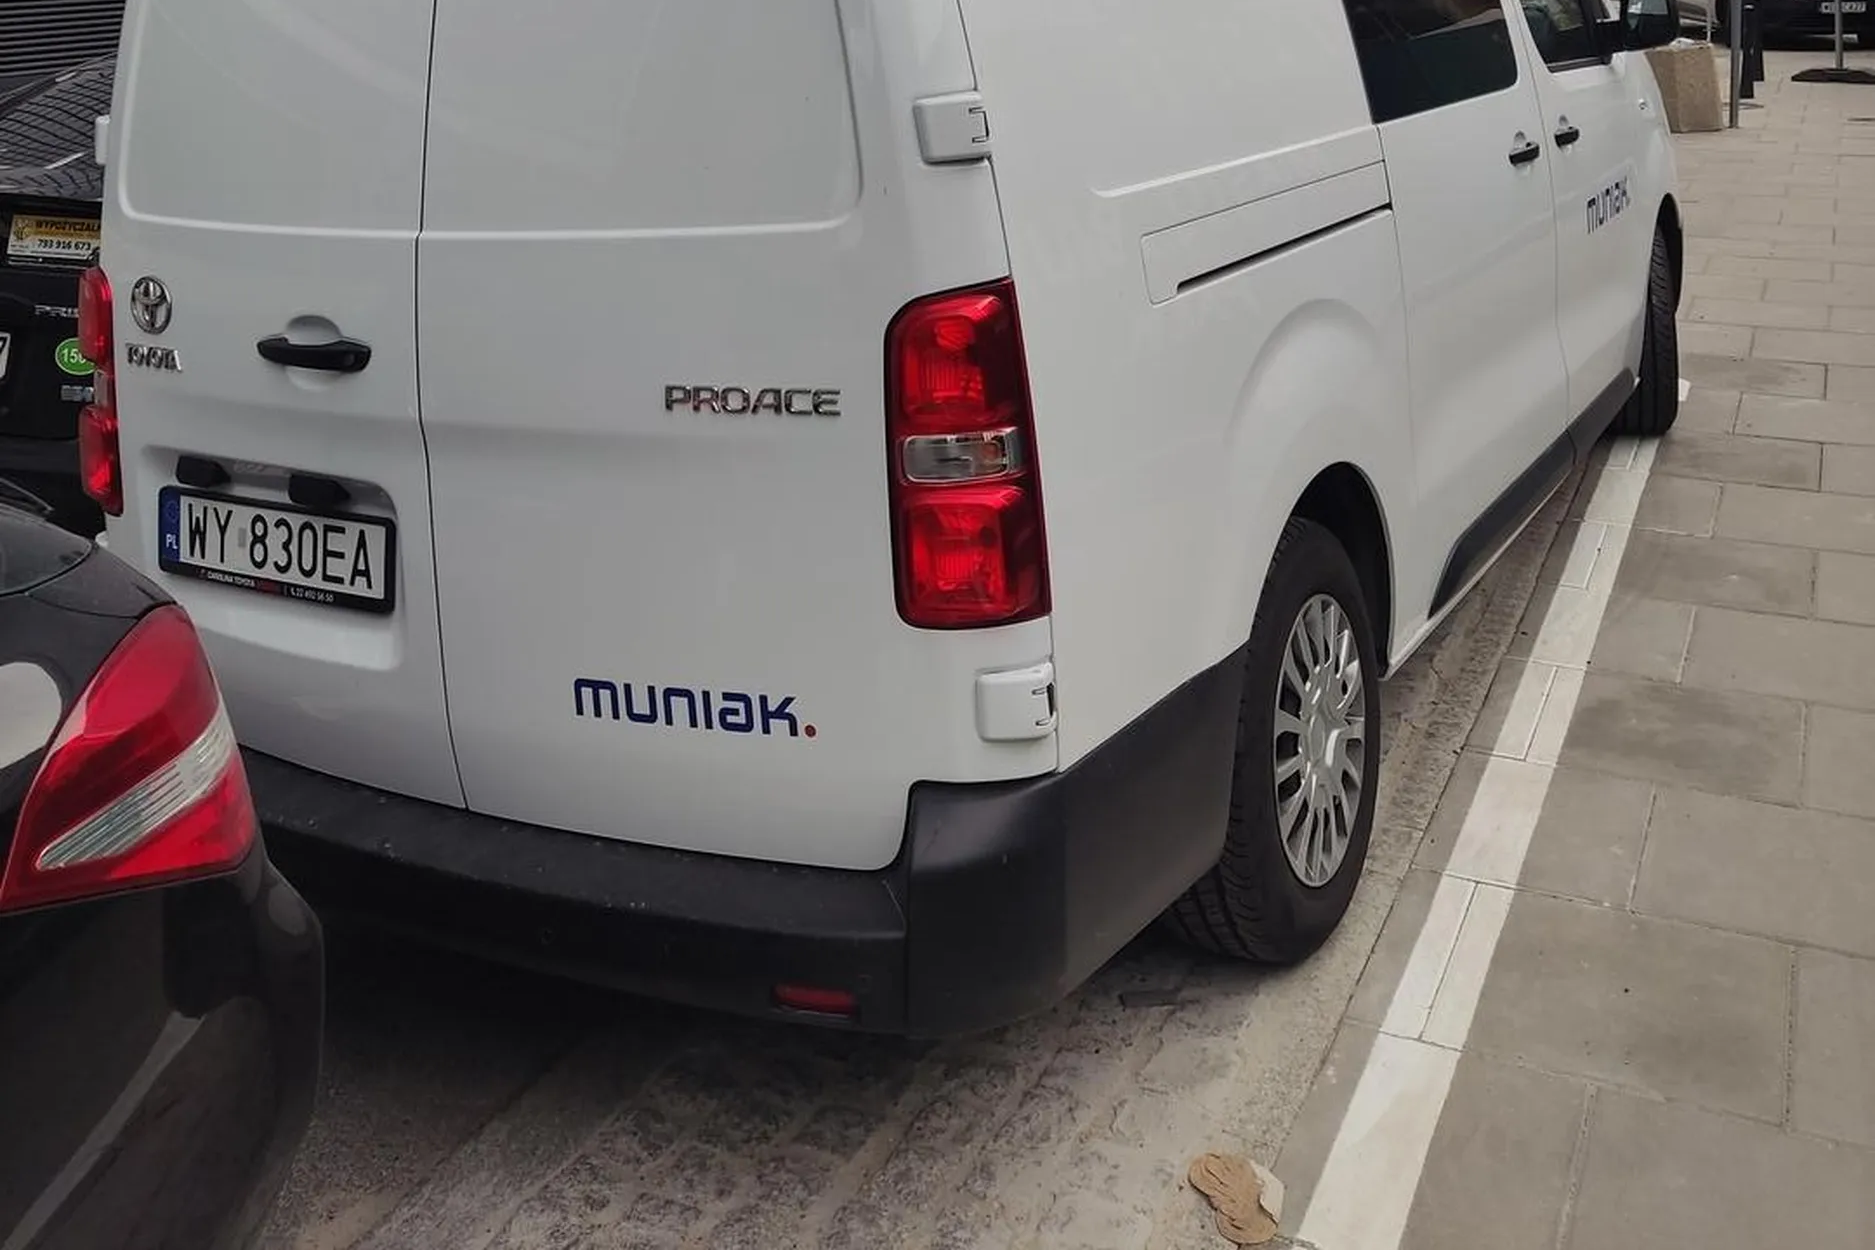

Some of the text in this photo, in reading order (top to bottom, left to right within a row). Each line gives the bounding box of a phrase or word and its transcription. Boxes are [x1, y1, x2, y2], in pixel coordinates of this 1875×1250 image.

[126, 343, 182, 372] TOYOTA
[664, 385, 842, 417] PROACE
[165, 533, 179, 550] PL
[187, 502, 373, 590] WY 830EA
